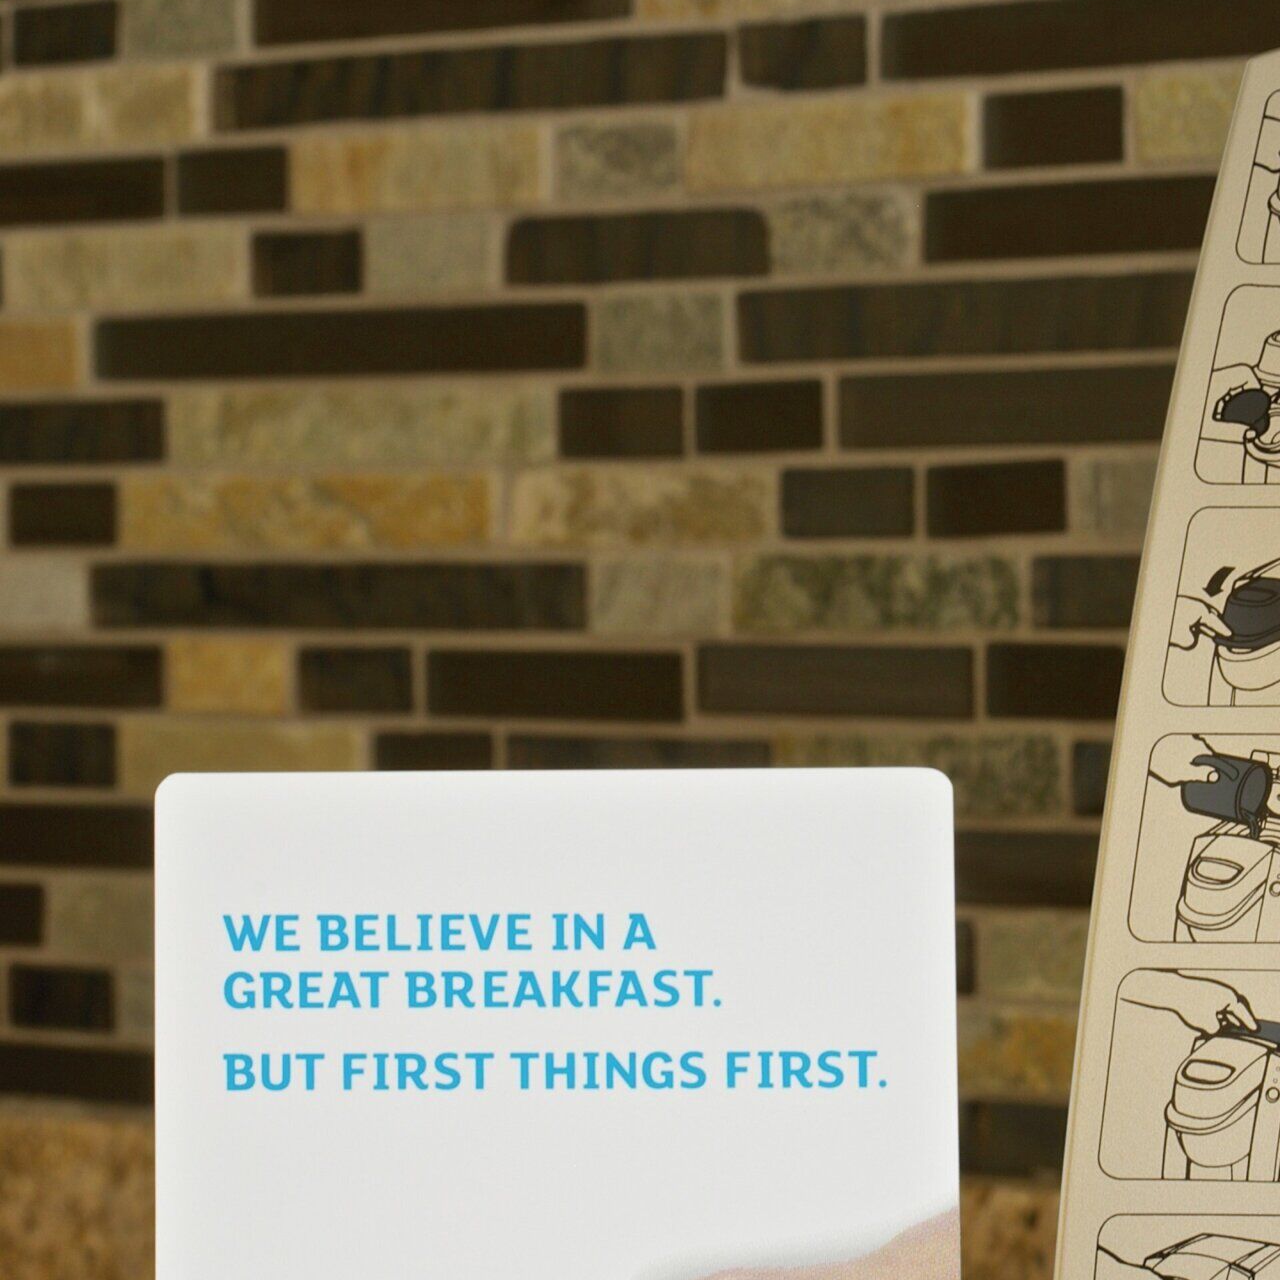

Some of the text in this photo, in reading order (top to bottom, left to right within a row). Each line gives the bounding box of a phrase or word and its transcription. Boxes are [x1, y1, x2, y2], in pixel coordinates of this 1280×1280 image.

[223, 913, 656, 952] WE BELIEVE IN A
[224, 970, 720, 1009] GREAT BREAKFAST.
[224, 1050, 887, 1091] BUT FIRST THINGS FIRST.
